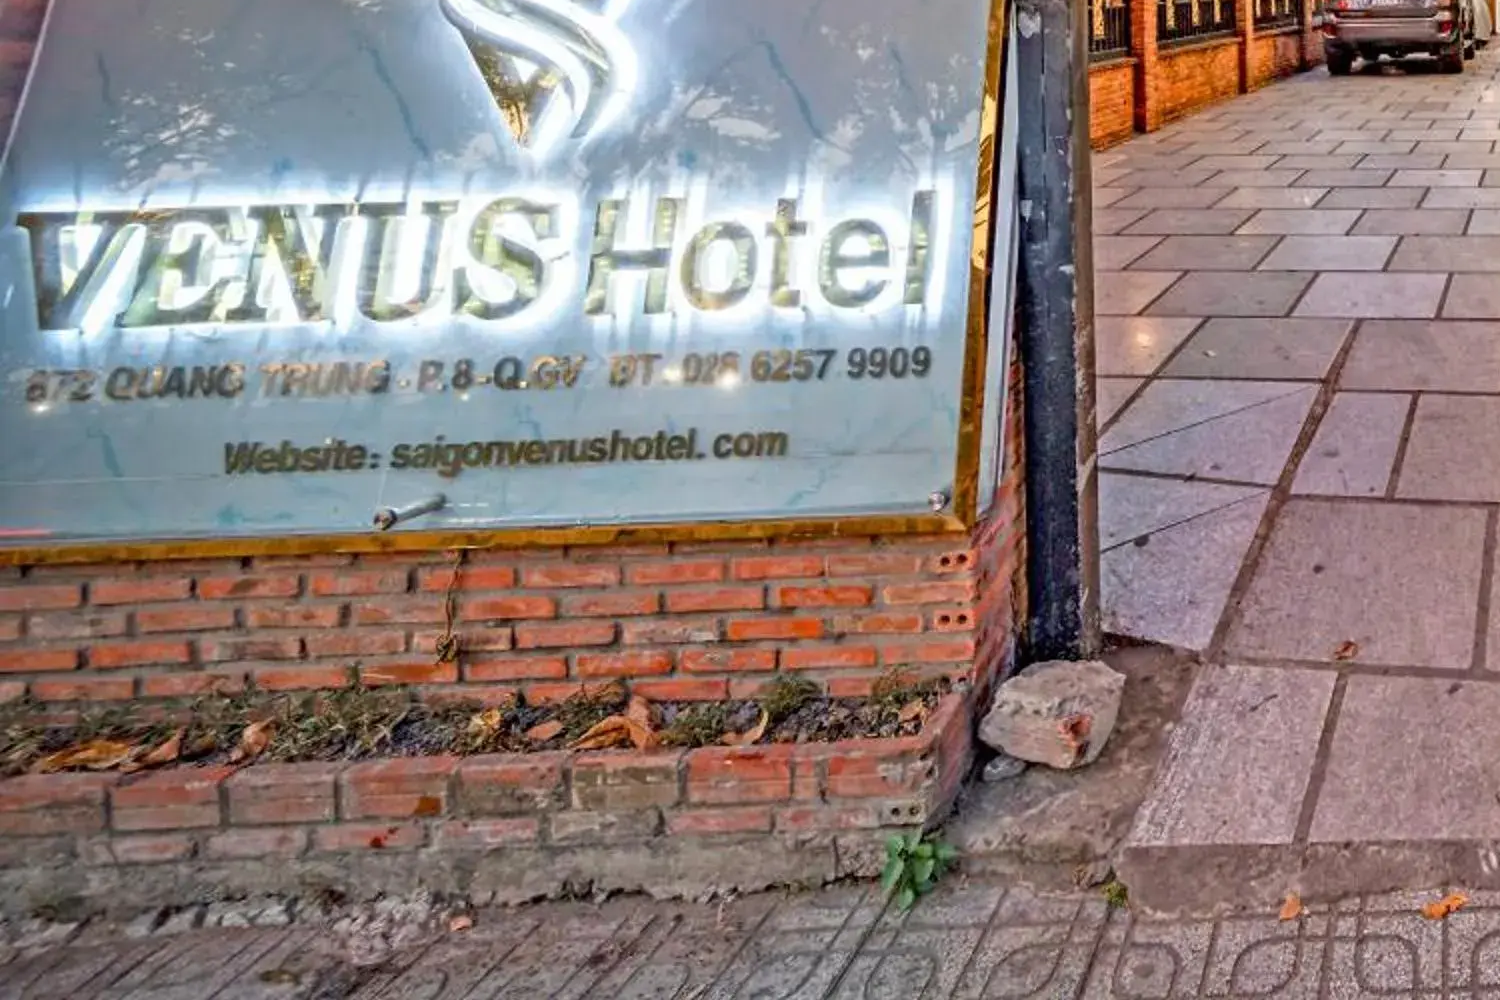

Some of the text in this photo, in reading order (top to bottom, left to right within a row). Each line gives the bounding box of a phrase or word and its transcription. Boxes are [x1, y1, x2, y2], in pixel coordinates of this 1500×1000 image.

[16, 189, 938, 331] VENUS Hotel
[105, 364, 244, 400] QUANG
[259, 359, 391, 397] TRUNG
[750, 349, 837, 383] 6257
[847, 345, 932, 379] 9909
